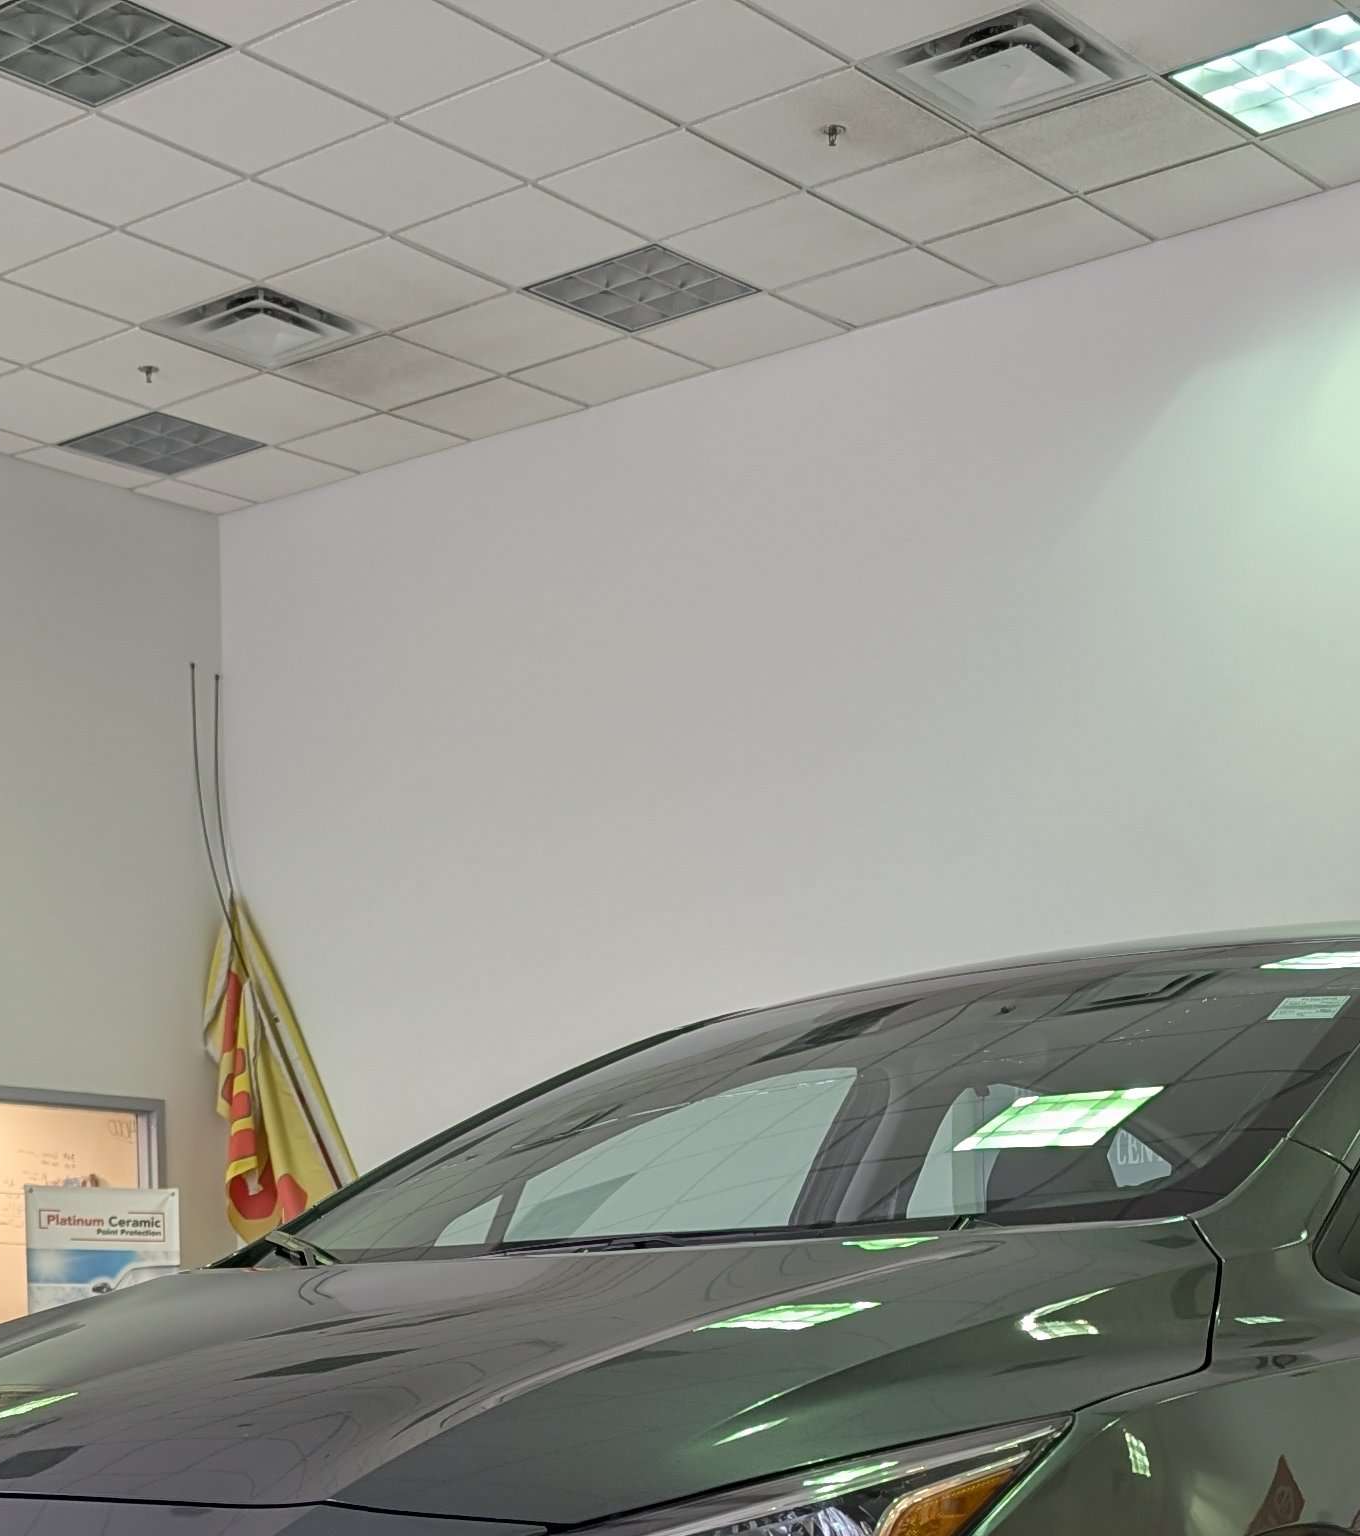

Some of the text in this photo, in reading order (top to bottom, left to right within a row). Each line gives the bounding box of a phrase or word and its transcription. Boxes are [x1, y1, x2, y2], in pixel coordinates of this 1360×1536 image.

[46, 1213, 162, 1229] Platinum Ceramic
[120, 1228, 162, 1237] Protection
